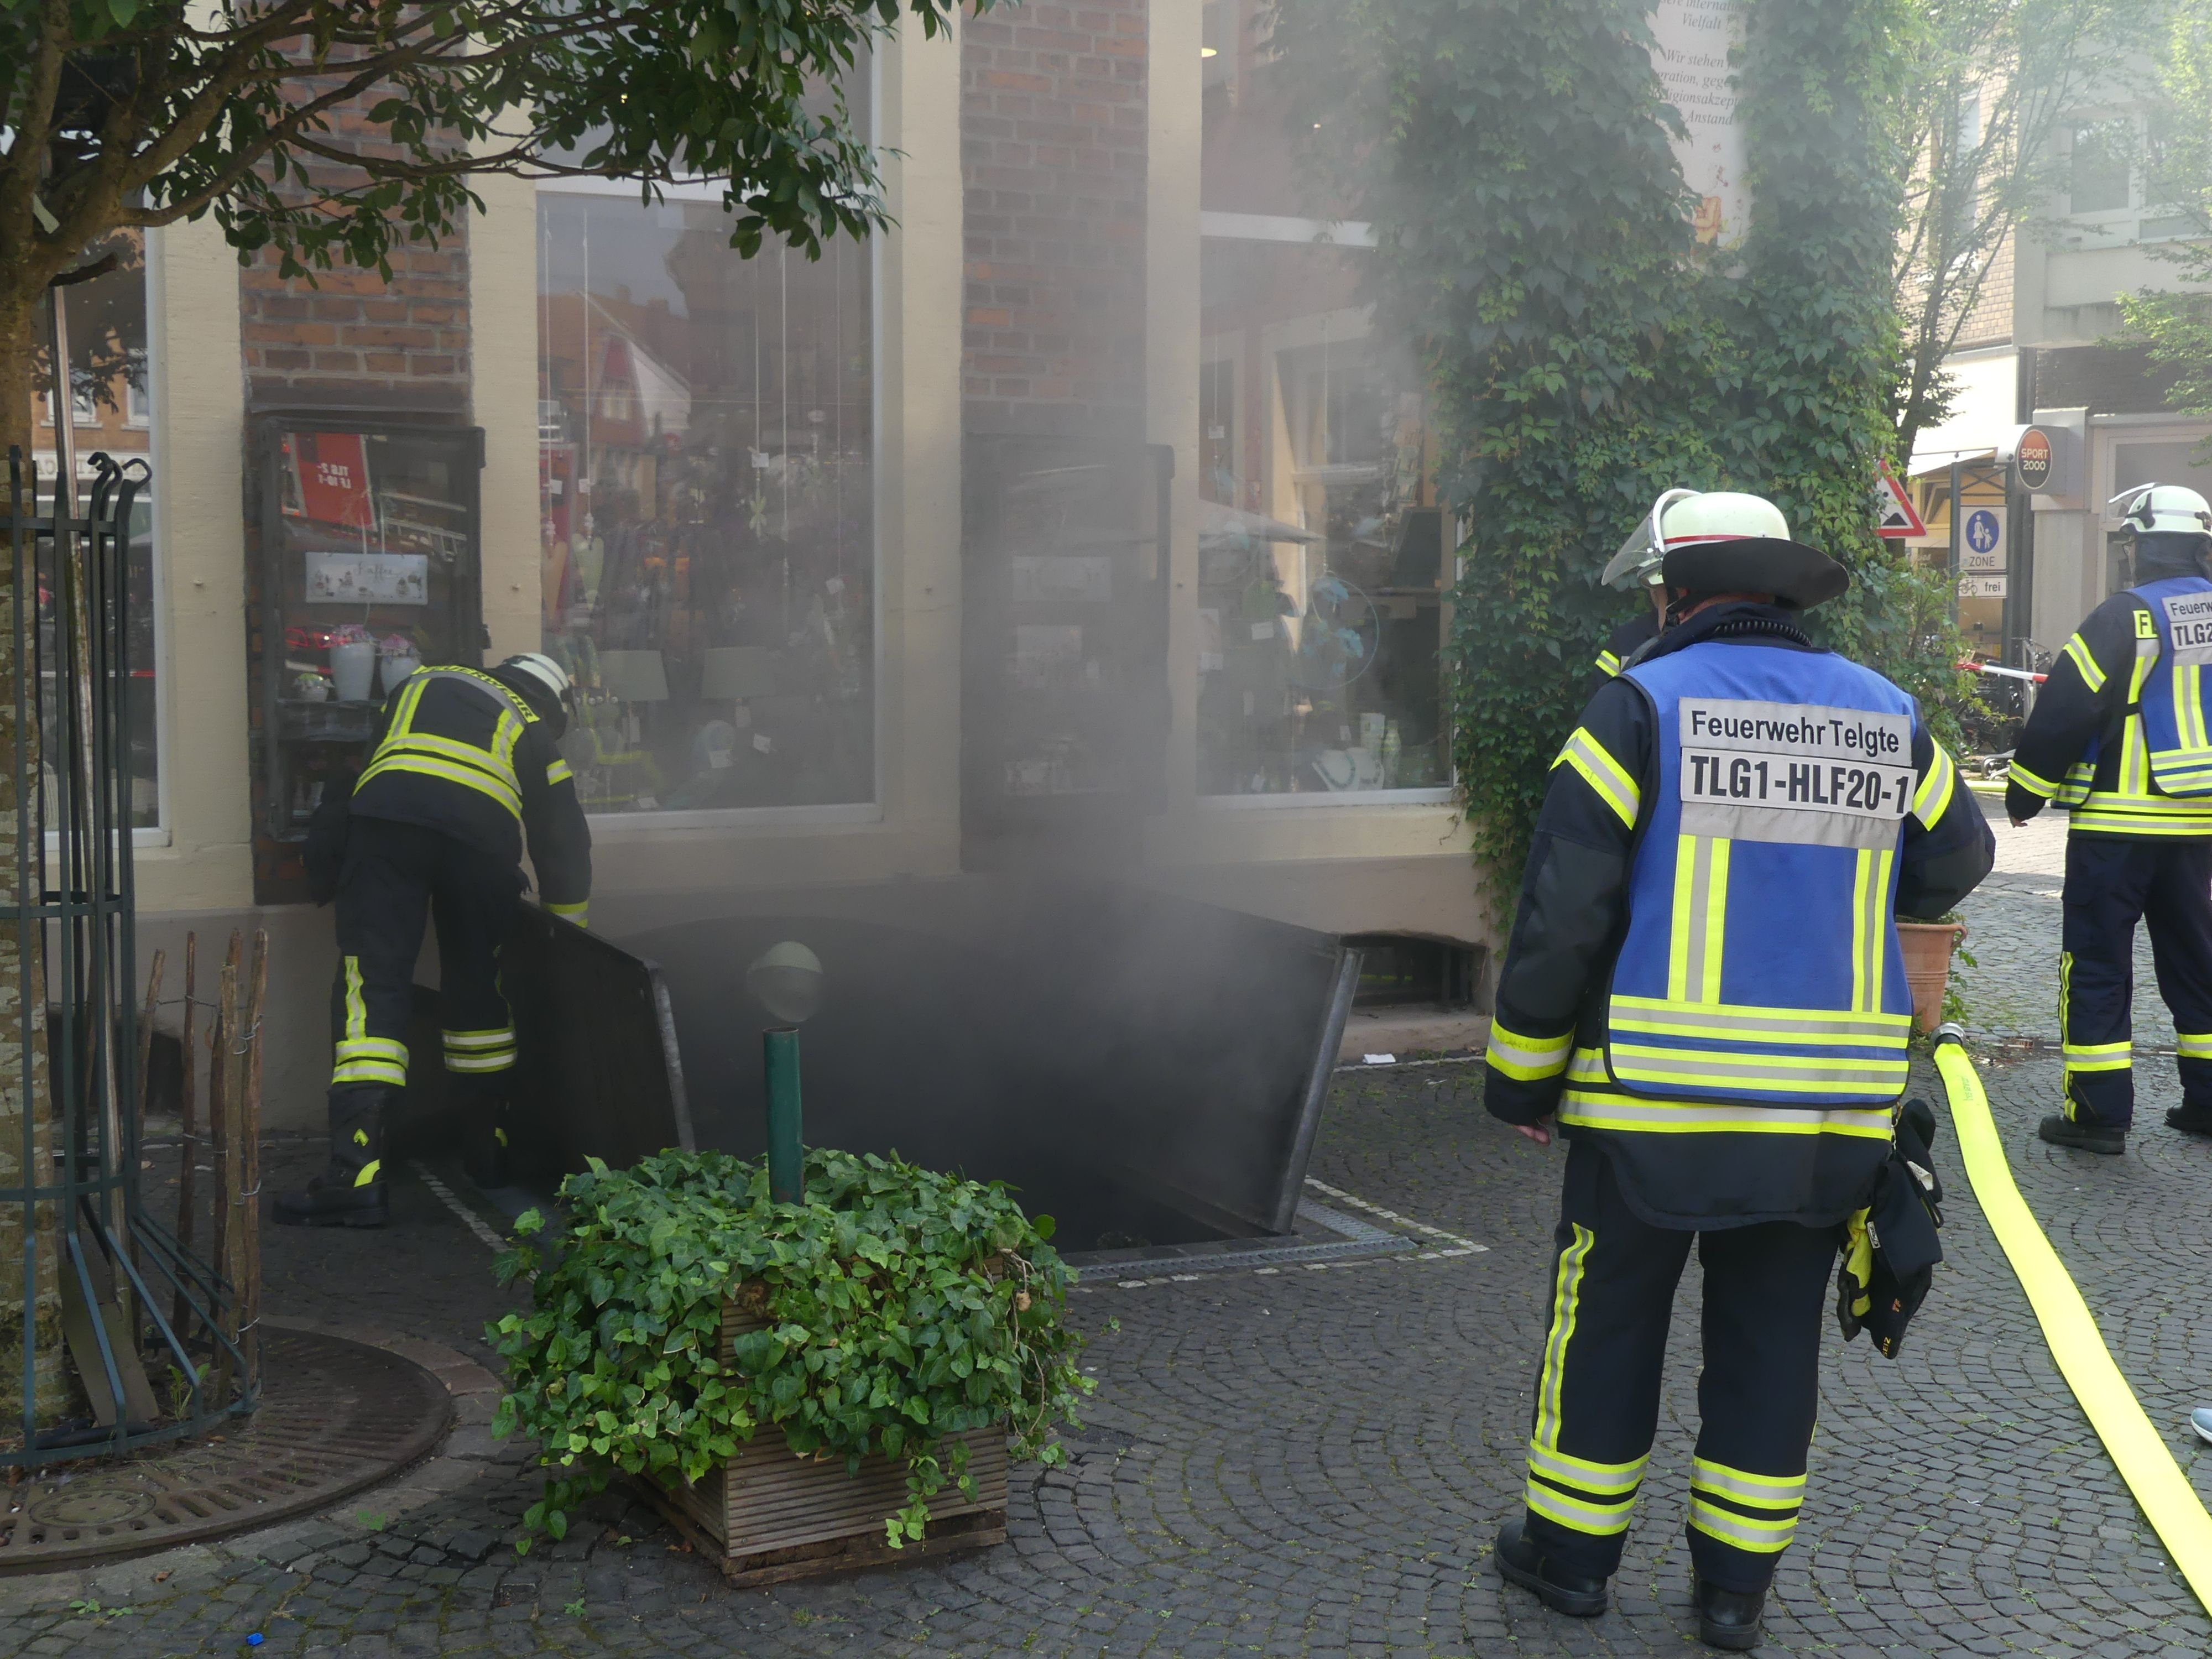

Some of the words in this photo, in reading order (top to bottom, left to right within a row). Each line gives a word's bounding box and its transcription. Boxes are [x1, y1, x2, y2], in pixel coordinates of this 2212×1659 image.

[1683, 13, 1721, 30] Vielfalt
[1666, 49, 1686, 64] Wir
[1688, 54, 1724, 68] stehen
[1660, 71, 1698, 86] ration,
[1686, 110, 1734, 125] Anstand
[2021, 448, 2048, 459] SPORT
[2023, 460, 2046, 471] 2000
[1969, 556, 1995, 567] ZONE
[1984, 582, 2001, 592] frei
[1691, 710, 1826, 745] Feuerwehr
[1829, 719, 1900, 758] Telgte
